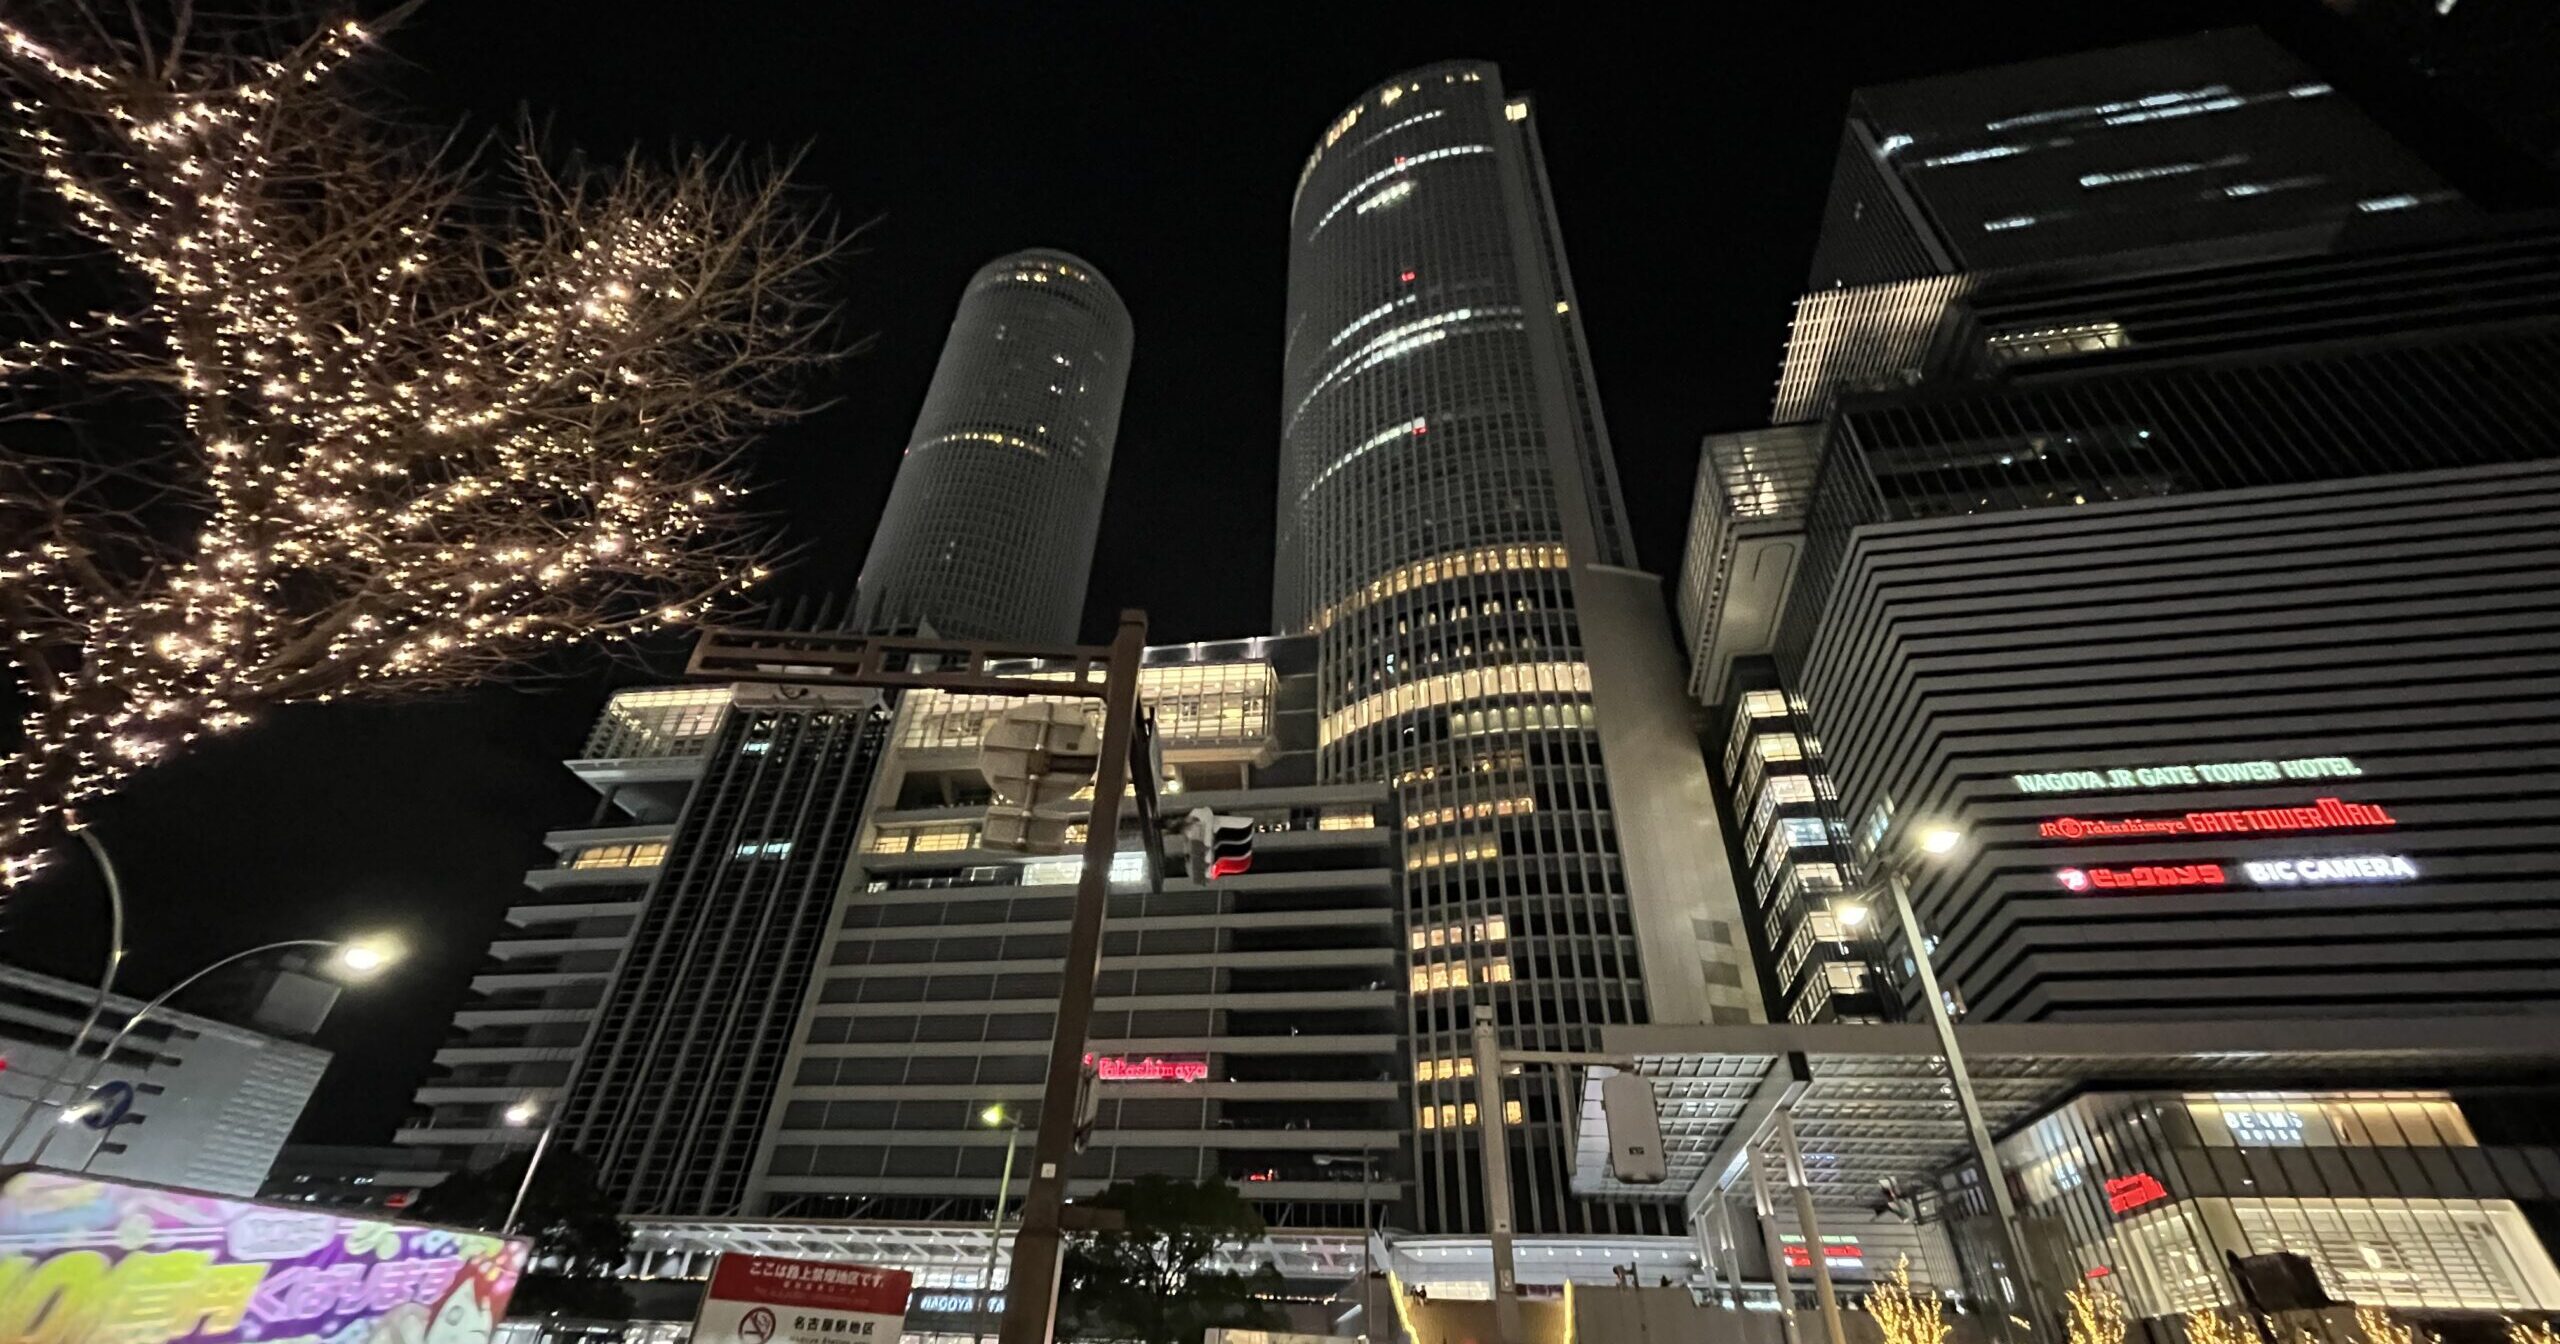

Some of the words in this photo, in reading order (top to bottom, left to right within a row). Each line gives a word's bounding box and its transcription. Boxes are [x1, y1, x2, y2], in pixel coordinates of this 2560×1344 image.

[2013, 770, 2106, 793] NAGOYA
[2107, 768, 2138, 788] JR
[2137, 765, 2197, 787] GATE
[2196, 761, 2282, 783] TOWER
[2280, 757, 2363, 779] HOTEL
[2040, 822, 2058, 837] JR
[2080, 818, 2187, 835] Takashimaya
[2088, 864, 2226, 888] ビックカメラ
[2243, 859, 2298, 884] BIC
[2297, 855, 2419, 881] CAMERA
[1098, 1056, 1209, 1083] Takashimaya
[920, 1295, 973, 1312] NAGOYA
[794, 1316, 876, 1336] 名古屋駅地区
